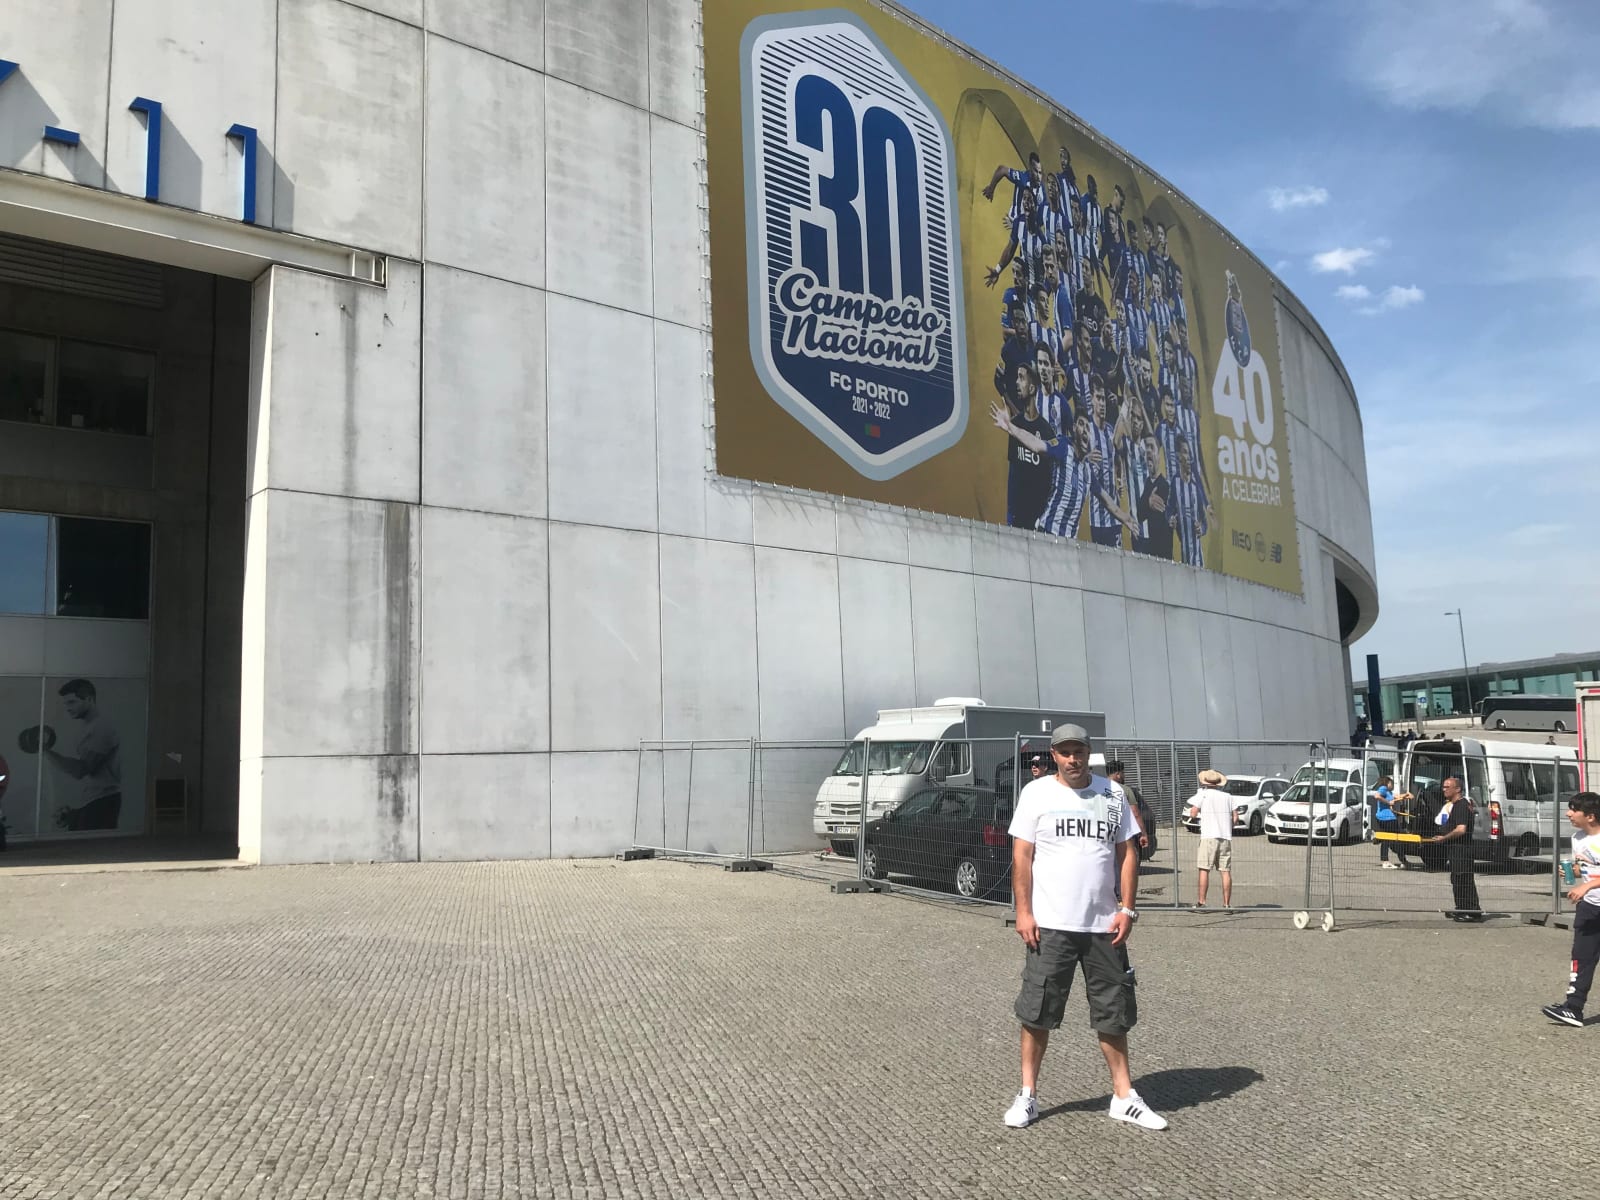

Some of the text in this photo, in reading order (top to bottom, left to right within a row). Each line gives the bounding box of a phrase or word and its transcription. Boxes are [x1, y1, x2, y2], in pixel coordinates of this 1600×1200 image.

[0, 59, 257, 224] -11
[794, 74, 924, 308] 30
[780, 273, 943, 333] Campeão
[787, 314, 935, 366] Nacional
[830, 370, 909, 407] FC PORTO
[852, 395, 891, 420] 2021 2022
[1212, 338, 1274, 446] 40
[1217, 435, 1280, 483] anos
[1222, 477, 1282, 507] A CELEBRAR
